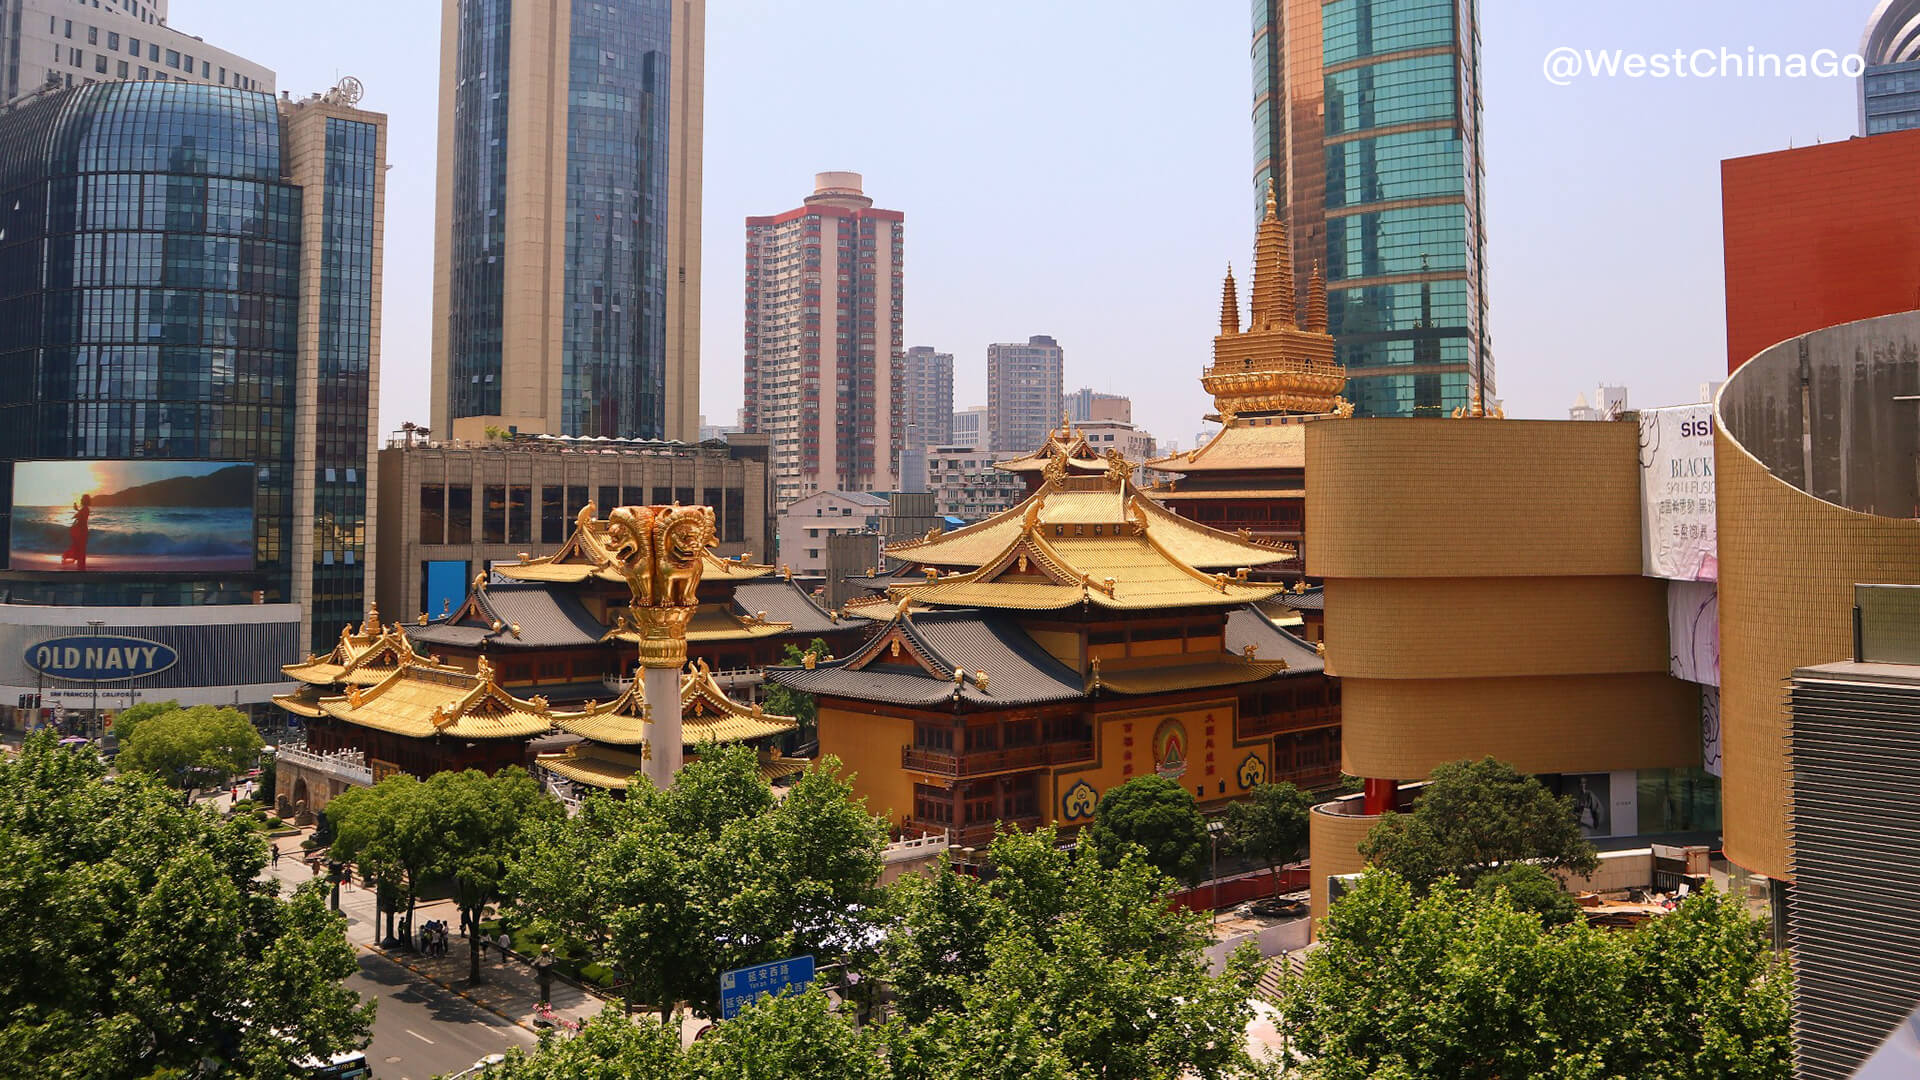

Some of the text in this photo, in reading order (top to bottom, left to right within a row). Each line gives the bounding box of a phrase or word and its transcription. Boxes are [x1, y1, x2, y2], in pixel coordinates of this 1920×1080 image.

[1671, 457, 1712, 478] BLACK
[36, 646, 158, 670] OLD NAVY
[748, 965, 789, 981] 延安西路
